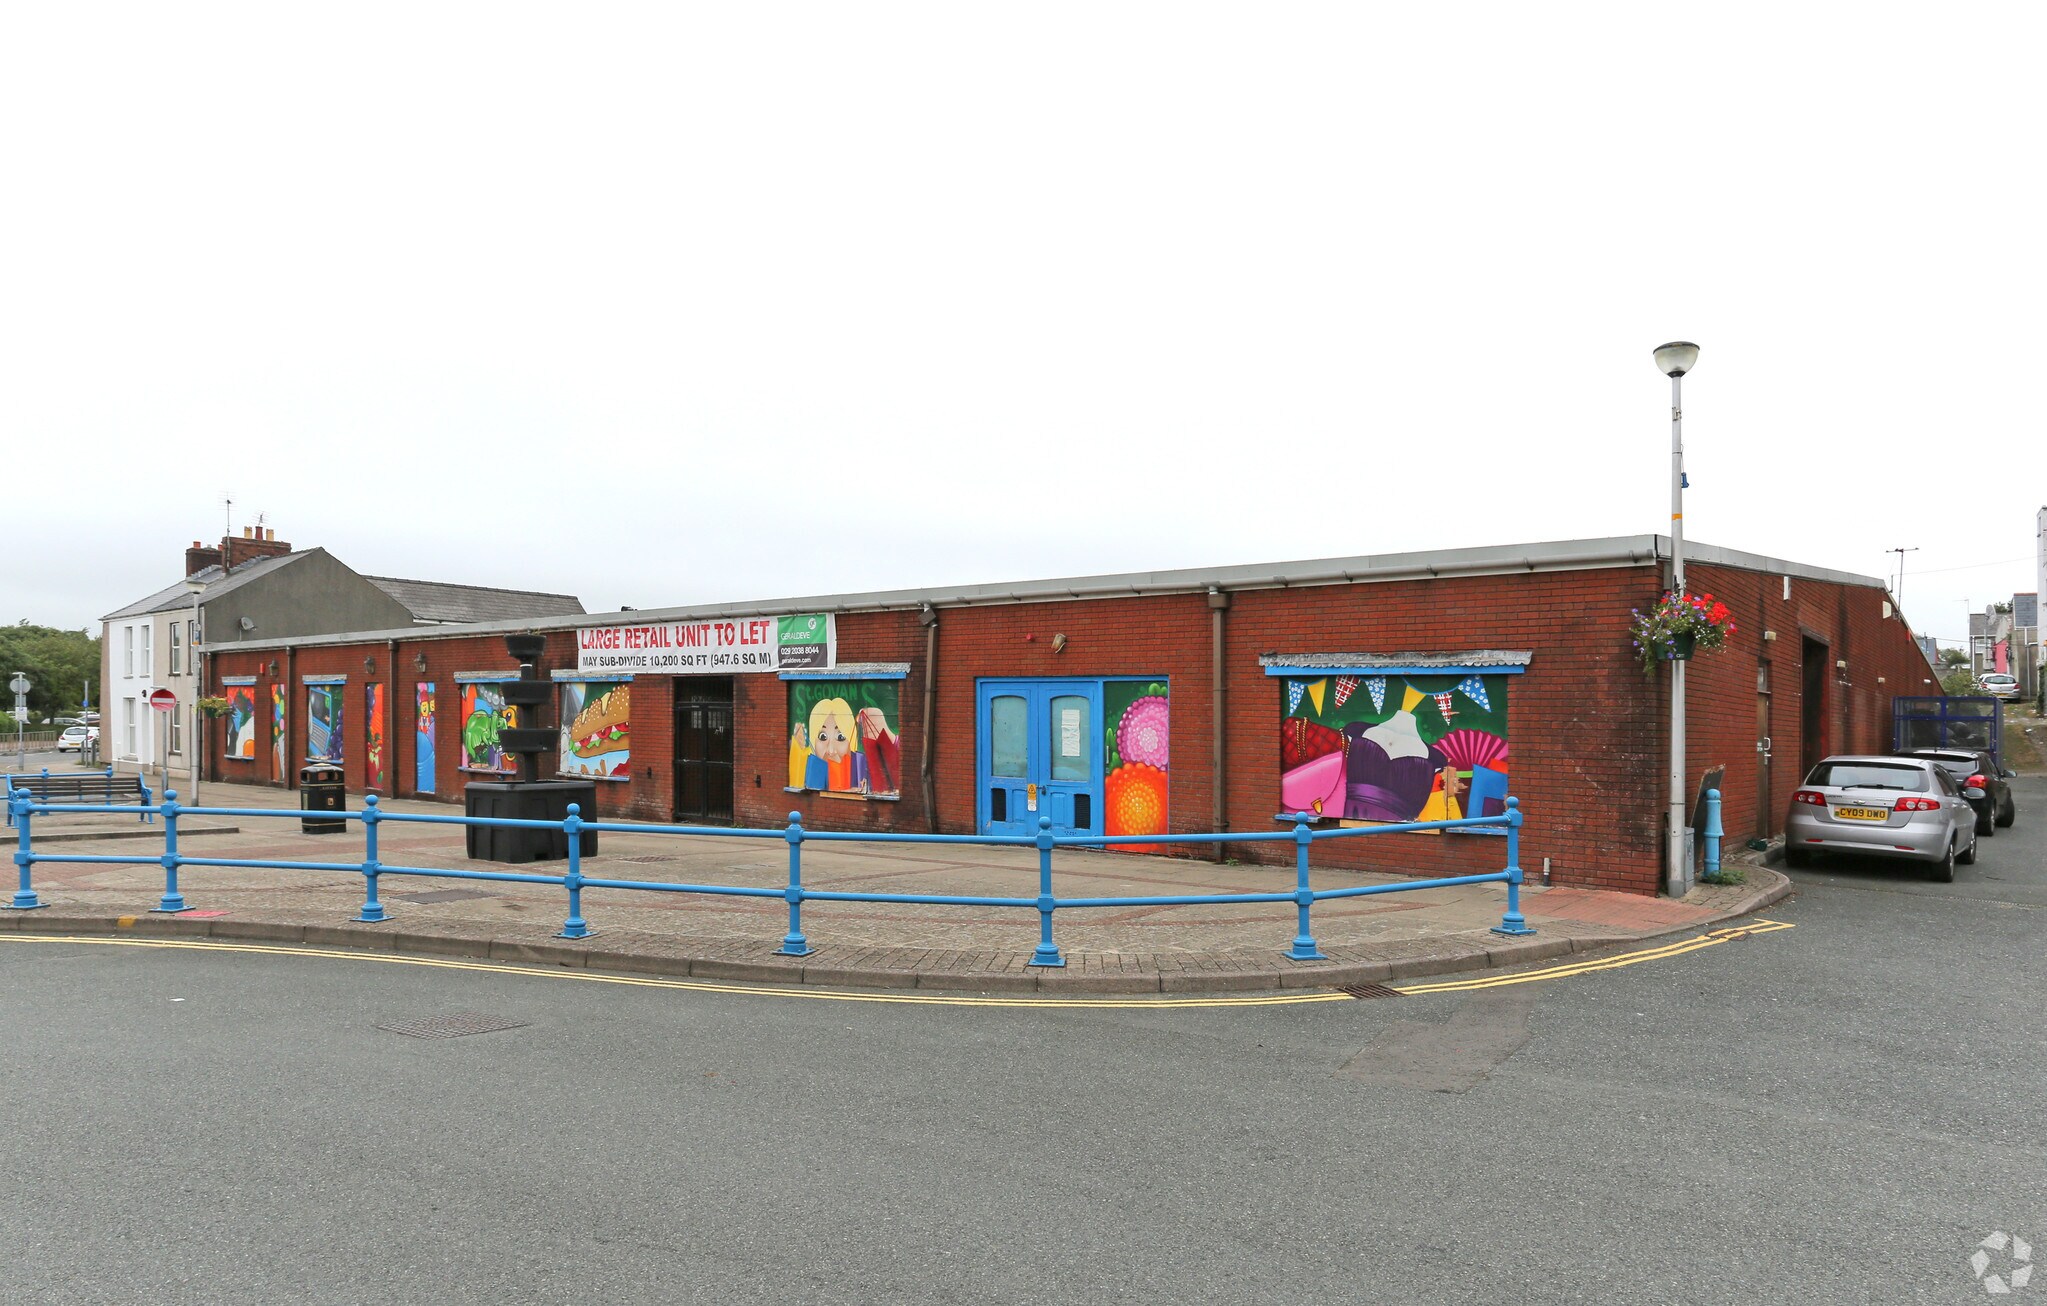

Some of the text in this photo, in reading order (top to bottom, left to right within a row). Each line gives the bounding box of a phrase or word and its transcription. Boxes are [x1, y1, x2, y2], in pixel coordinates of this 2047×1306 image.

[581, 620, 770, 649] LARGE RETAIL UNIT TO LET
[780, 646, 819, 655] 029 2038 8044
[582, 652, 771, 668] MAY SUB-DIVIDE 10,200 SQ FT (947.6 SQ M)
[1839, 808, 1865, 818] CY09
